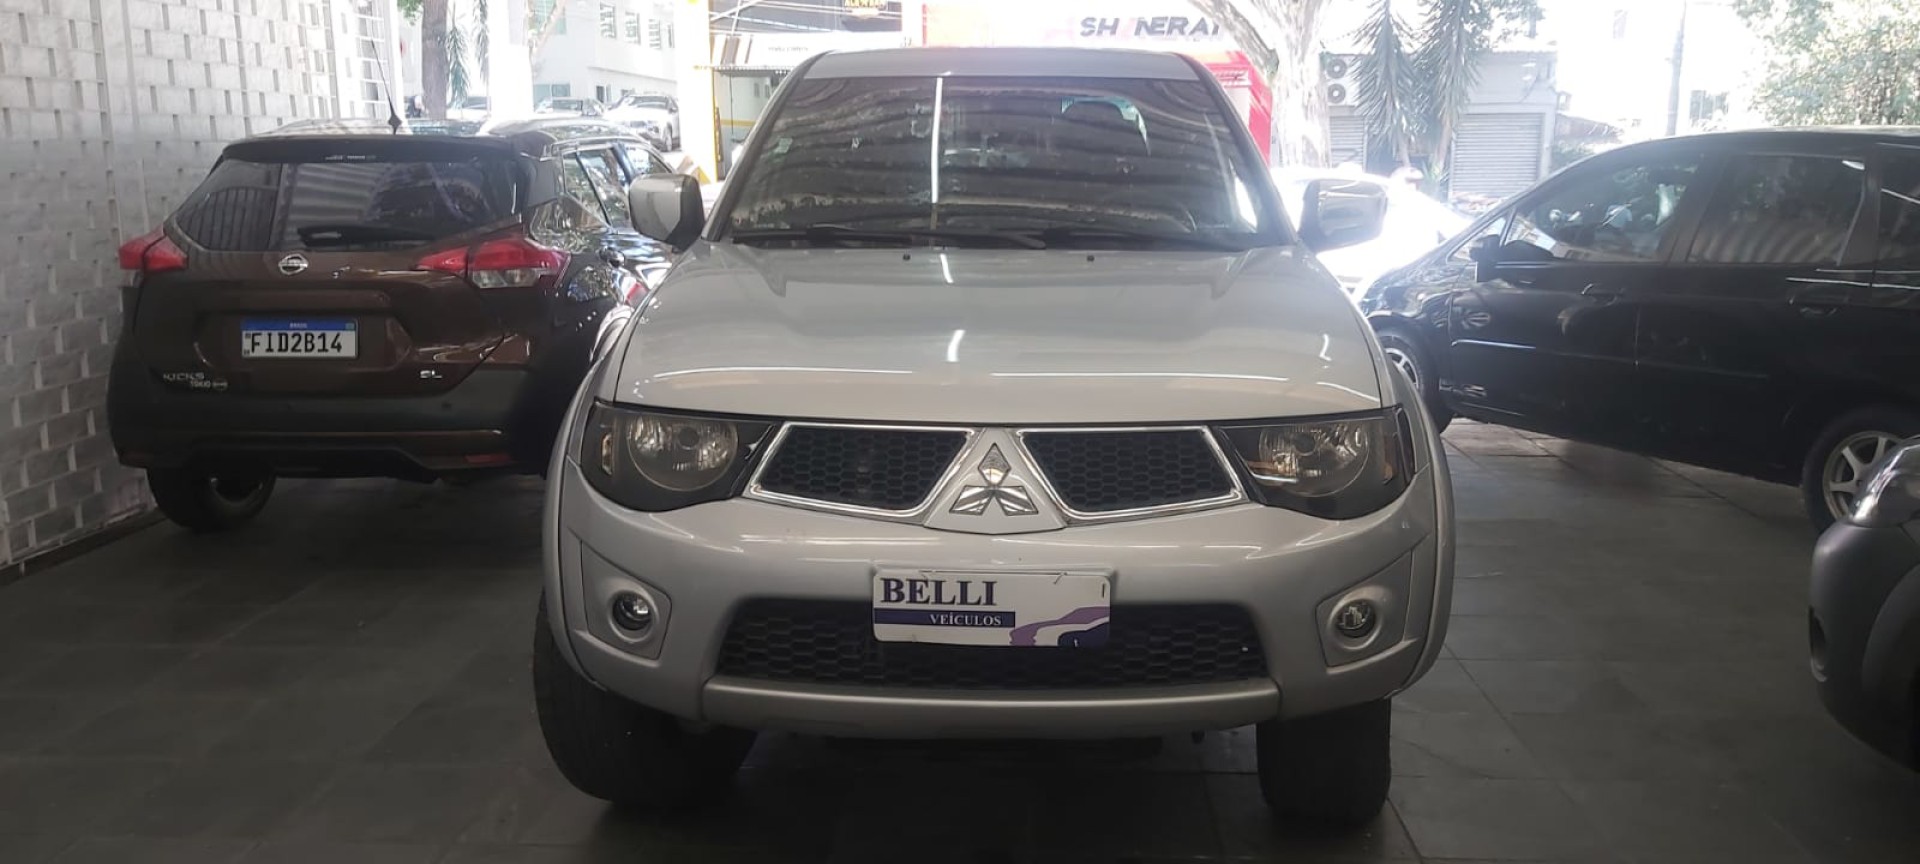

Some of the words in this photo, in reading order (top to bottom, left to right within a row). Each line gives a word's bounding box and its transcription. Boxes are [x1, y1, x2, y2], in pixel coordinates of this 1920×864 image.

[251, 332, 342, 353] FID2B14
[880, 577, 998, 606] BELLI
[929, 612, 1001, 626] VEÍCULOS
